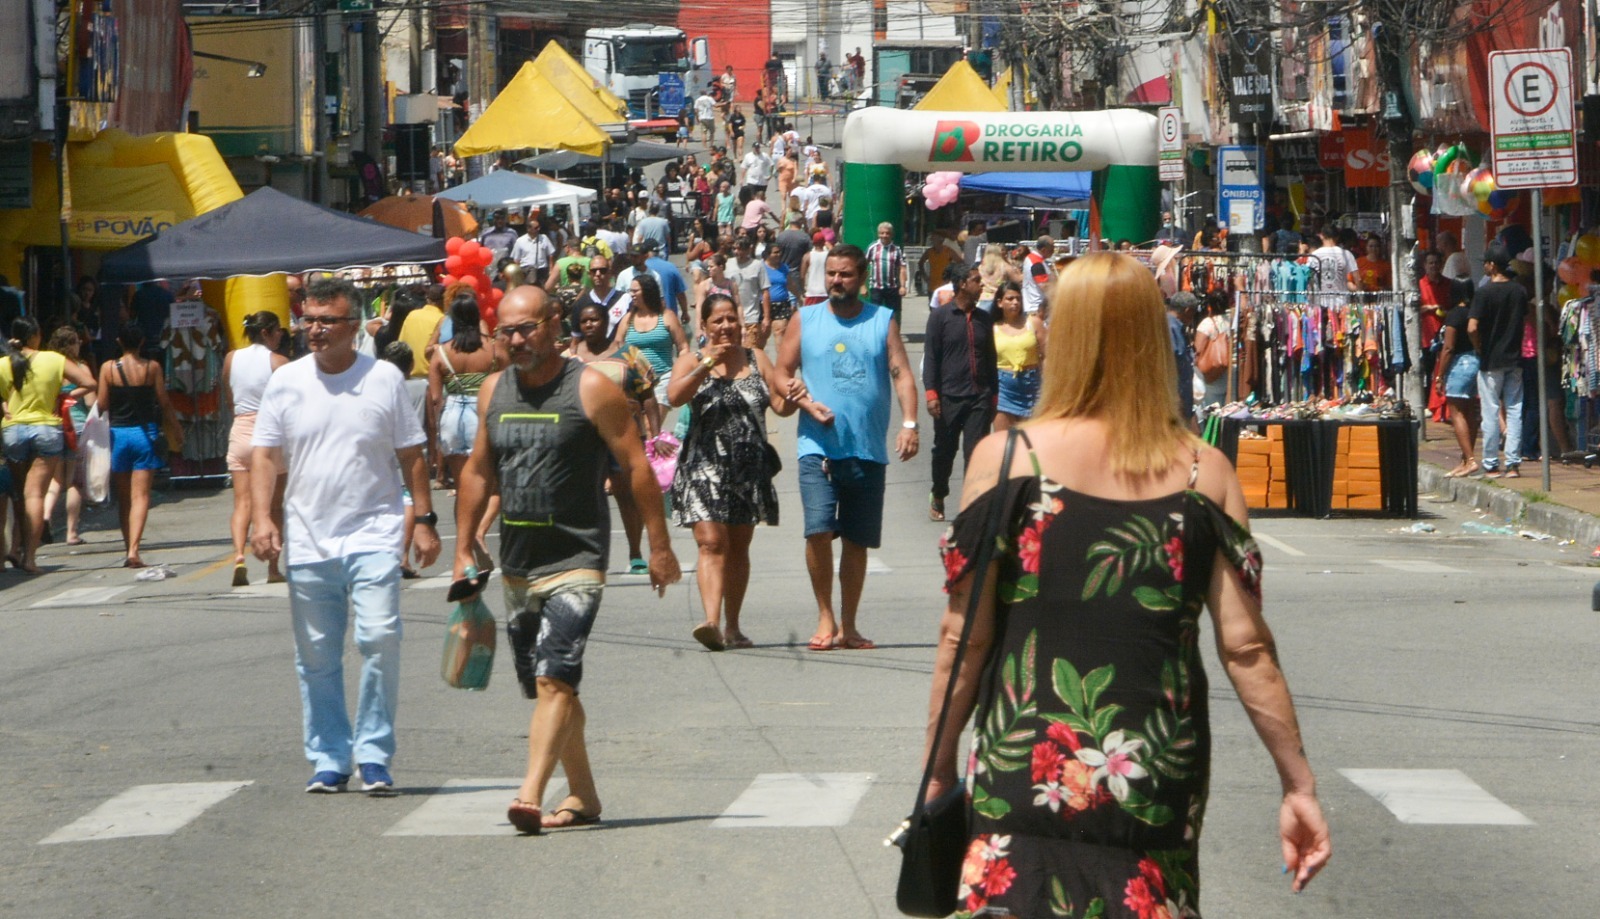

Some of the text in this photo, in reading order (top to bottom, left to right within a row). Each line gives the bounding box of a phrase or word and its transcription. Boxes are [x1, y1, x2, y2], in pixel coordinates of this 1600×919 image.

[1522, 74, 1540, 103] E
[985, 124, 1083, 138] DROGARIA
[1167, 120, 1173, 135] E
[983, 141, 1083, 163] RETIRO
[1278, 143, 1316, 159] VALE
[1222, 188, 1260, 198] ÔNIBUS
